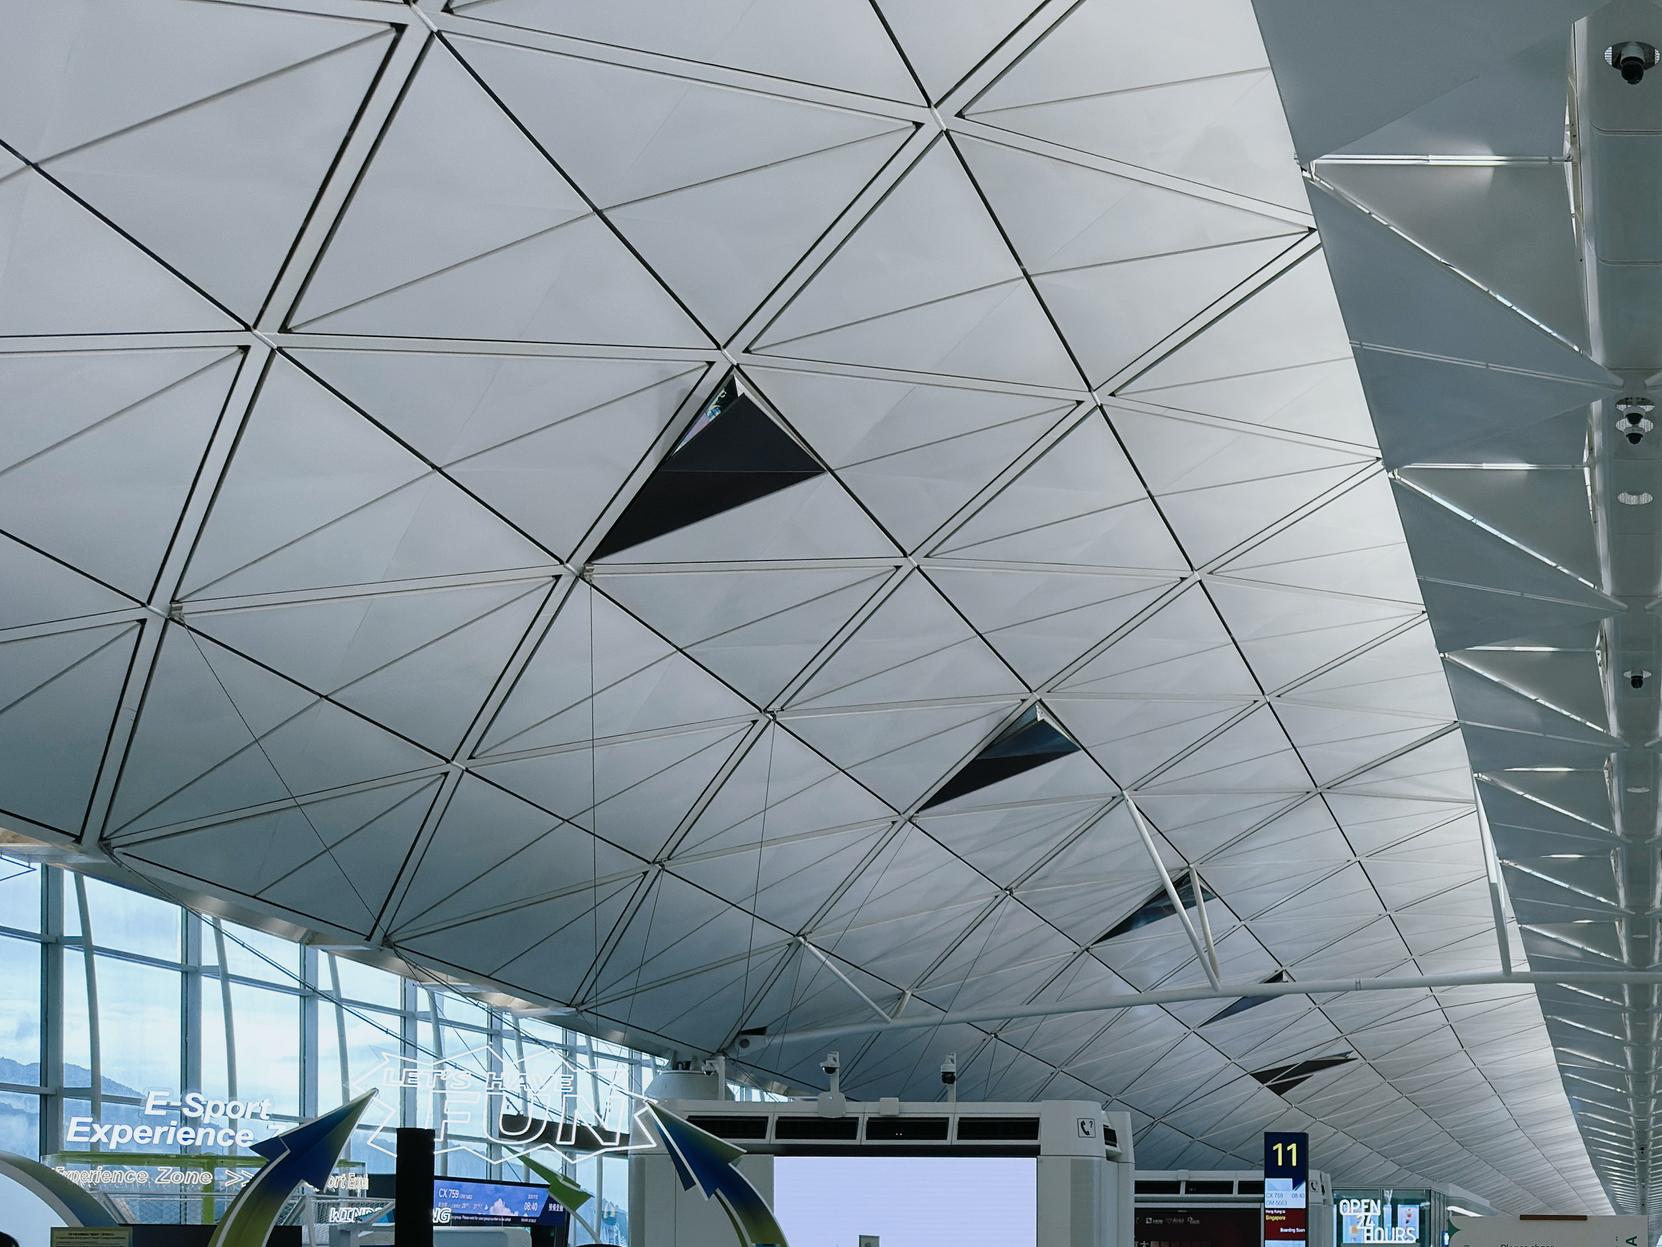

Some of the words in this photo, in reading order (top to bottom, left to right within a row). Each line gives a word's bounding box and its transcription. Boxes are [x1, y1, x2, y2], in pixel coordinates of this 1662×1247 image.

[384, 1068, 474, 1090] LET'S
[487, 1072, 574, 1093] HAVE
[144, 1090, 271, 1122] E-Sport
[428, 1092, 628, 1146] FUN
[67, 1116, 254, 1149] Experience
[1272, 1143, 1297, 1167] 11
[155, 1166, 213, 1186] Zone
[1340, 1199, 1381, 1216] OPEN
[1357, 1214, 1375, 1229] 24
[1364, 1226, 1417, 1243] HOURS
